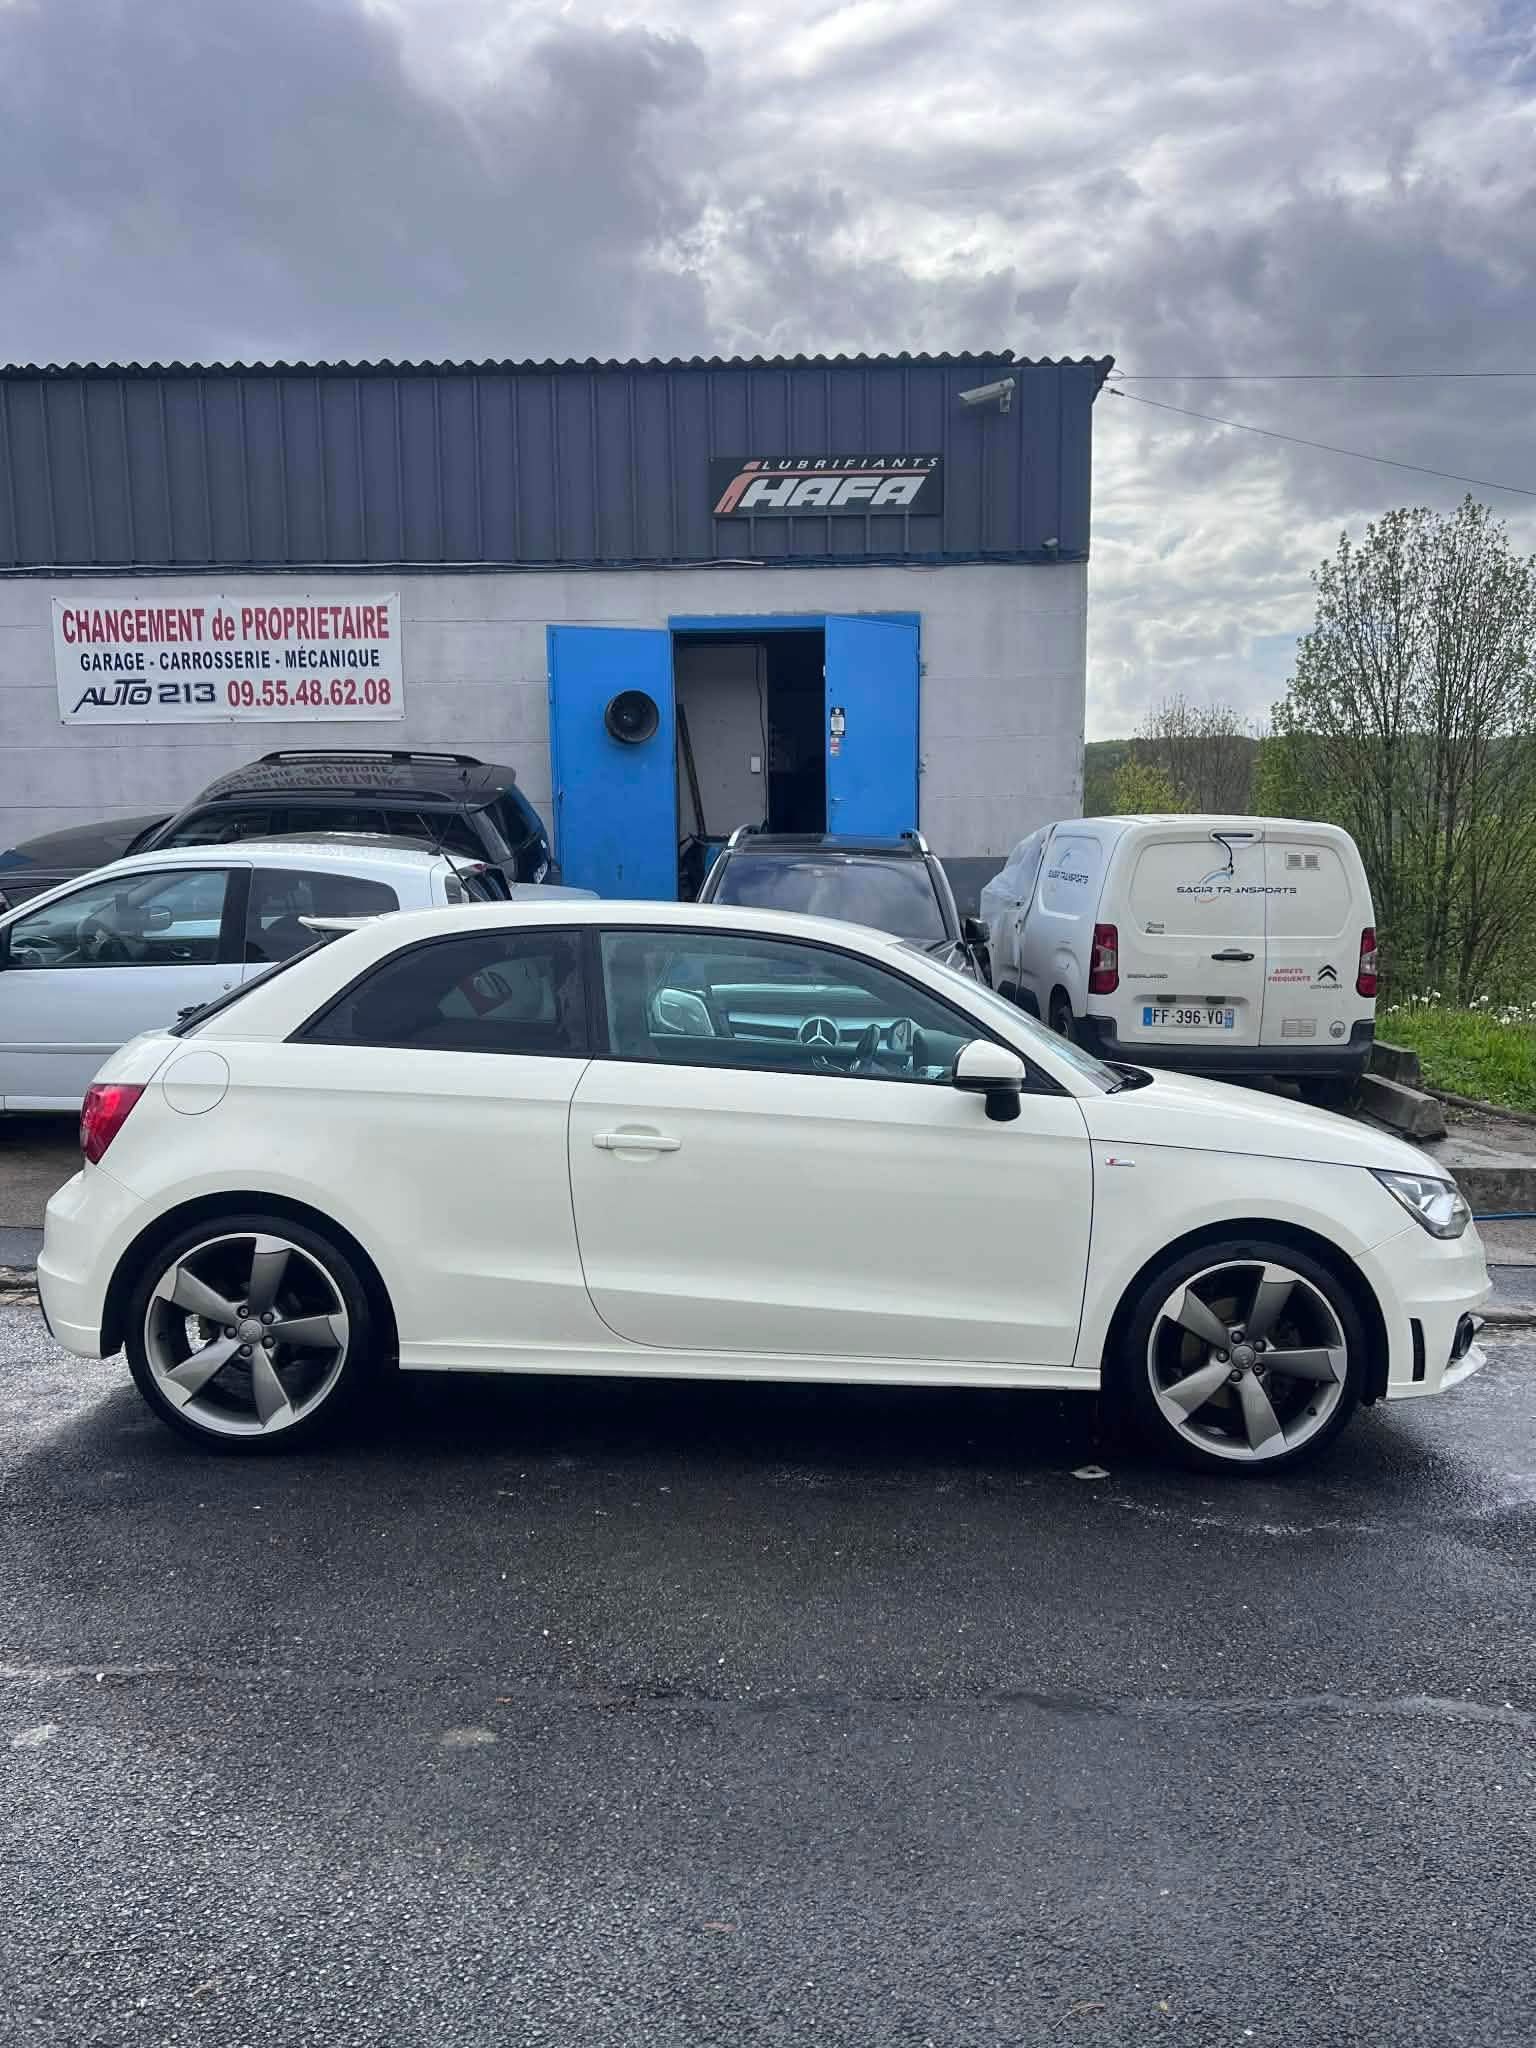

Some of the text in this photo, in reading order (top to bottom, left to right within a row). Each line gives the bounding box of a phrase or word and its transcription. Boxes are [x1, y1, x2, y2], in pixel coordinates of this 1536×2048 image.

[761, 457, 939, 471] LUBRIFIANTS
[738, 476, 926, 507] HAFA
[62, 605, 390, 644] CHANGEMENT de PROPRIETAIRE
[80, 652, 145, 672] GARAGE
[159, 650, 271, 671] CARROSSERIE
[285, 645, 380, 669] MÉCANIQUE
[70, 678, 217, 714] AUTO 213
[227, 678, 391, 707] 09.55.48.62.08
[1176, 886, 1213, 894] SAGIR
